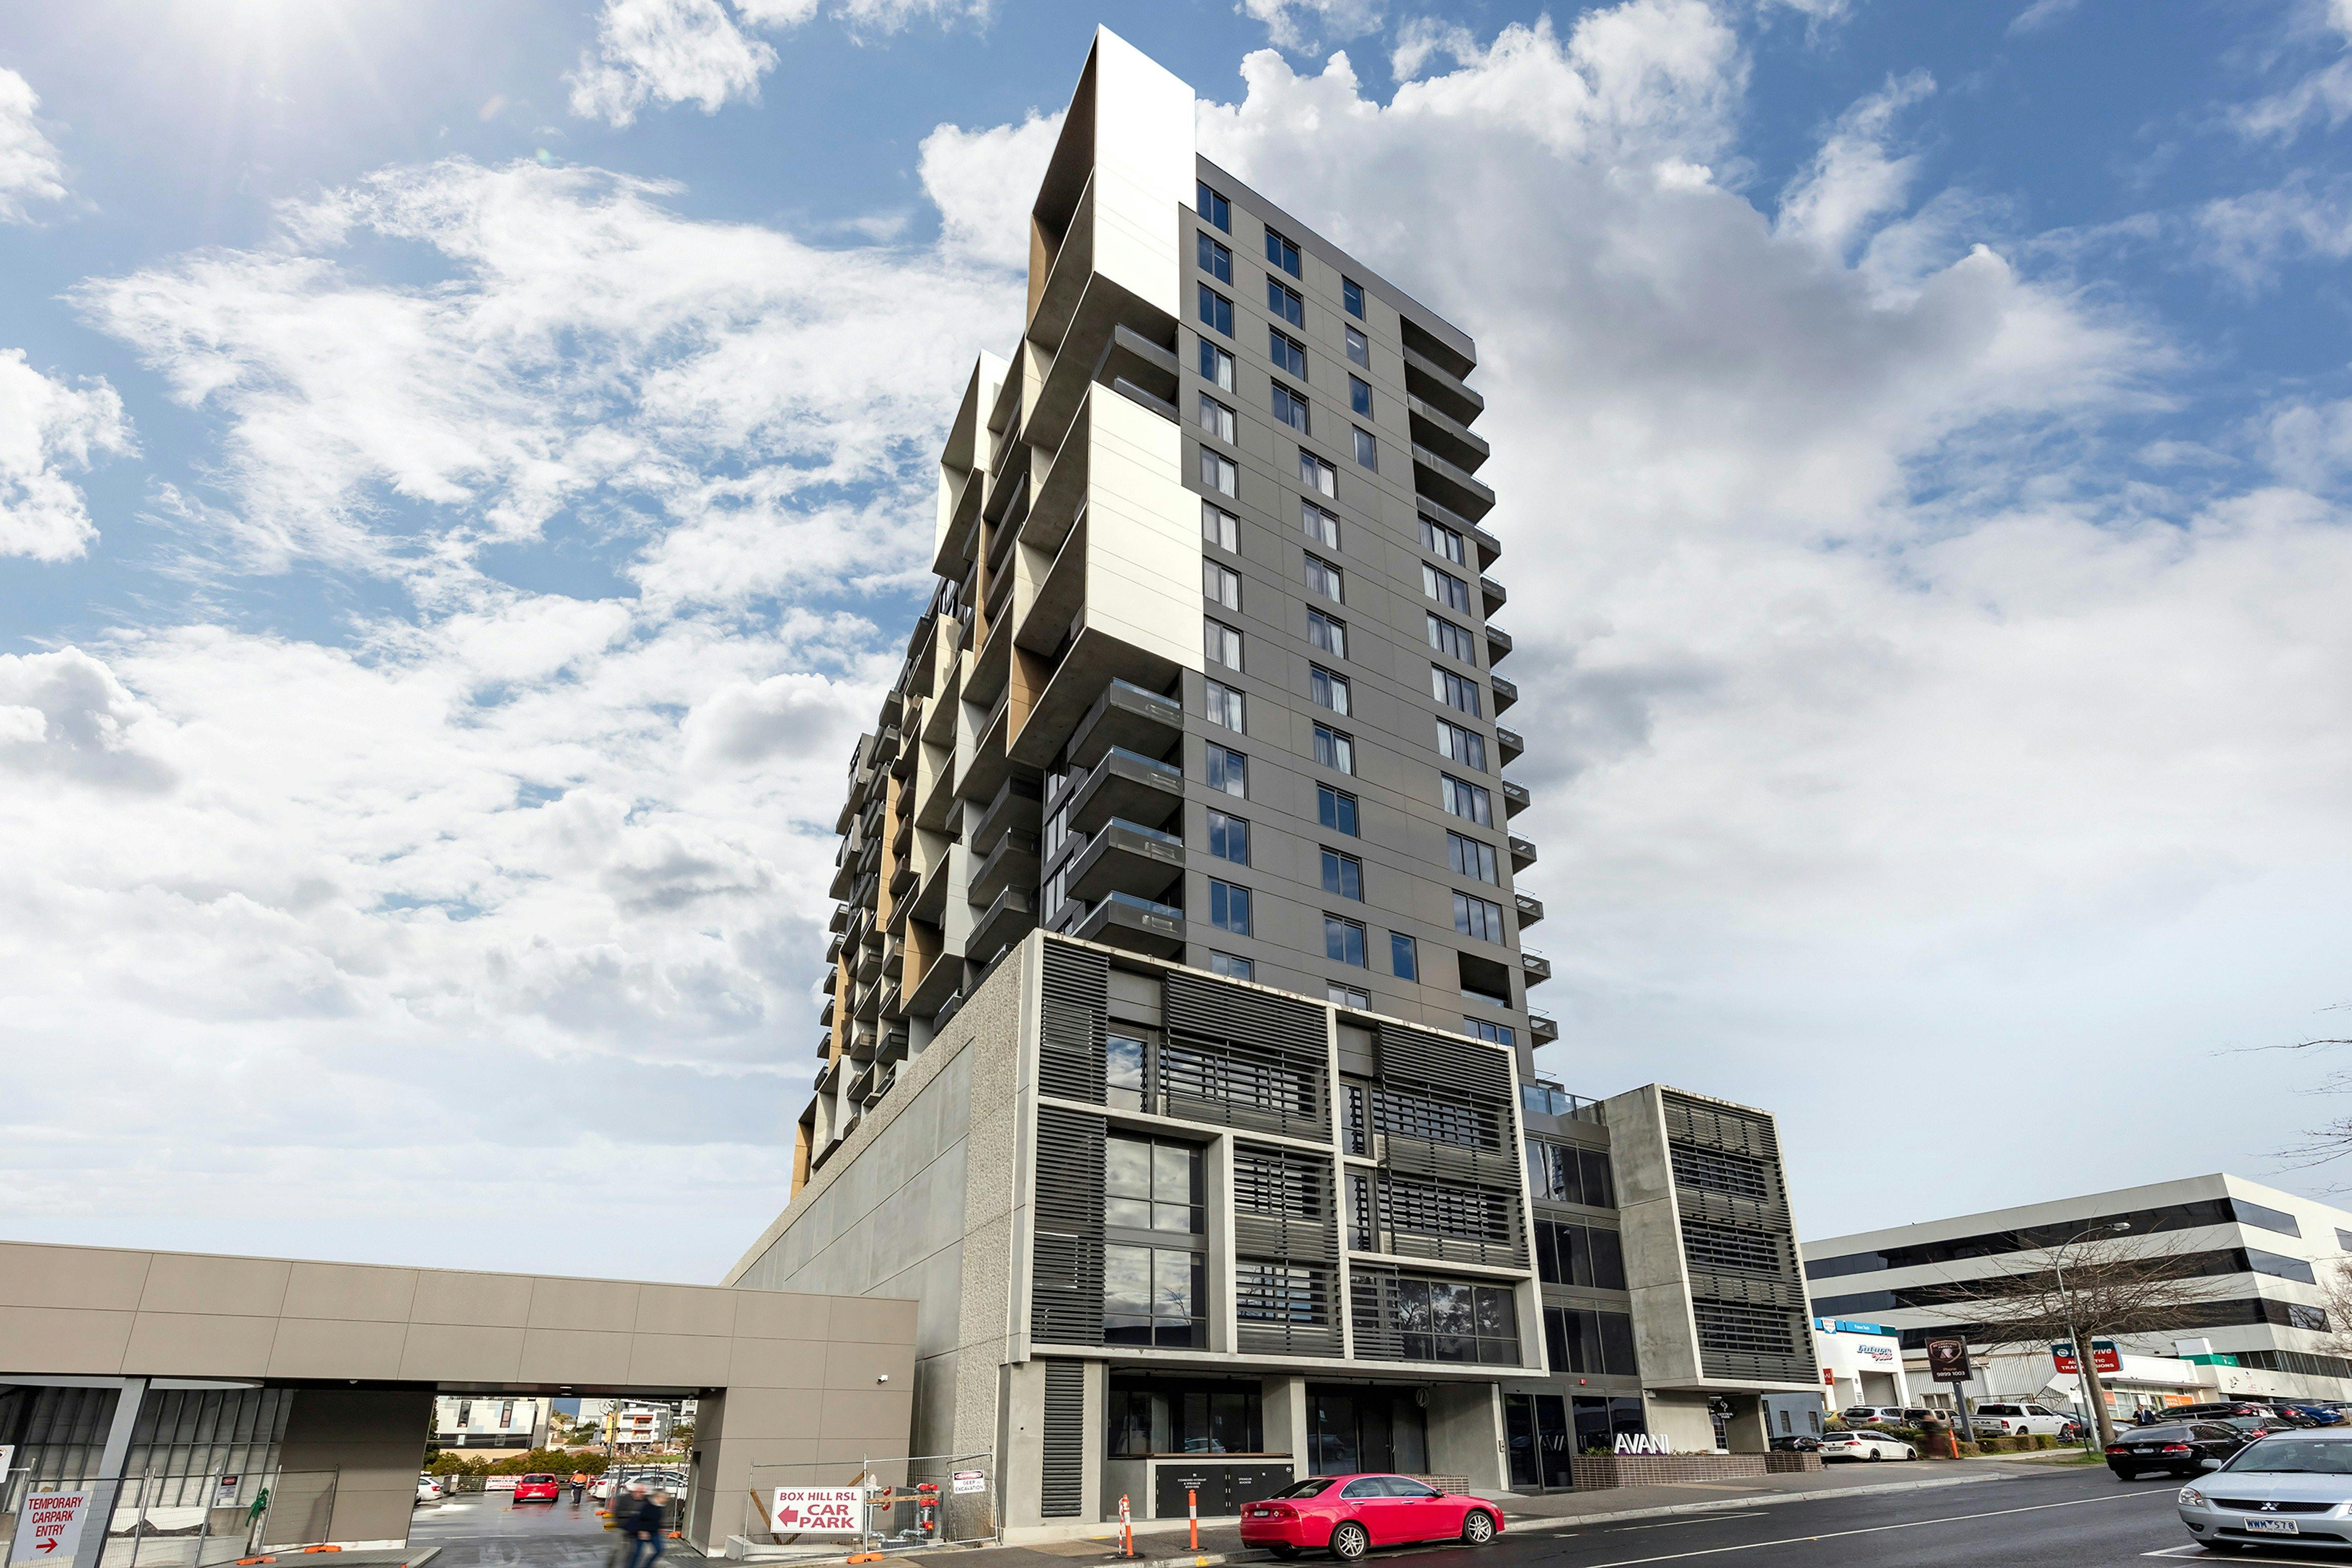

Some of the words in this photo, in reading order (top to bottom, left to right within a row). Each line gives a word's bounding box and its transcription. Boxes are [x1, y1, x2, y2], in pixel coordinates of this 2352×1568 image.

[1857, 1344, 1892, 1353] Future
[1614, 1434, 1670, 1454] AVANI
[780, 1492, 804, 1501] BOX
[808, 1492, 832, 1501] HILL
[836, 1492, 857, 1501] RSL
[28, 1497, 84, 1510] TEMPORARY
[807, 1504, 849, 1515] CAR
[32, 1510, 74, 1524] CARPARK
[799, 1517, 854, 1528] PARK
[35, 1524, 65, 1537] ENTRY
[2246, 1520, 2267, 1528] WWM
[2274, 1521, 2294, 1530] 578
